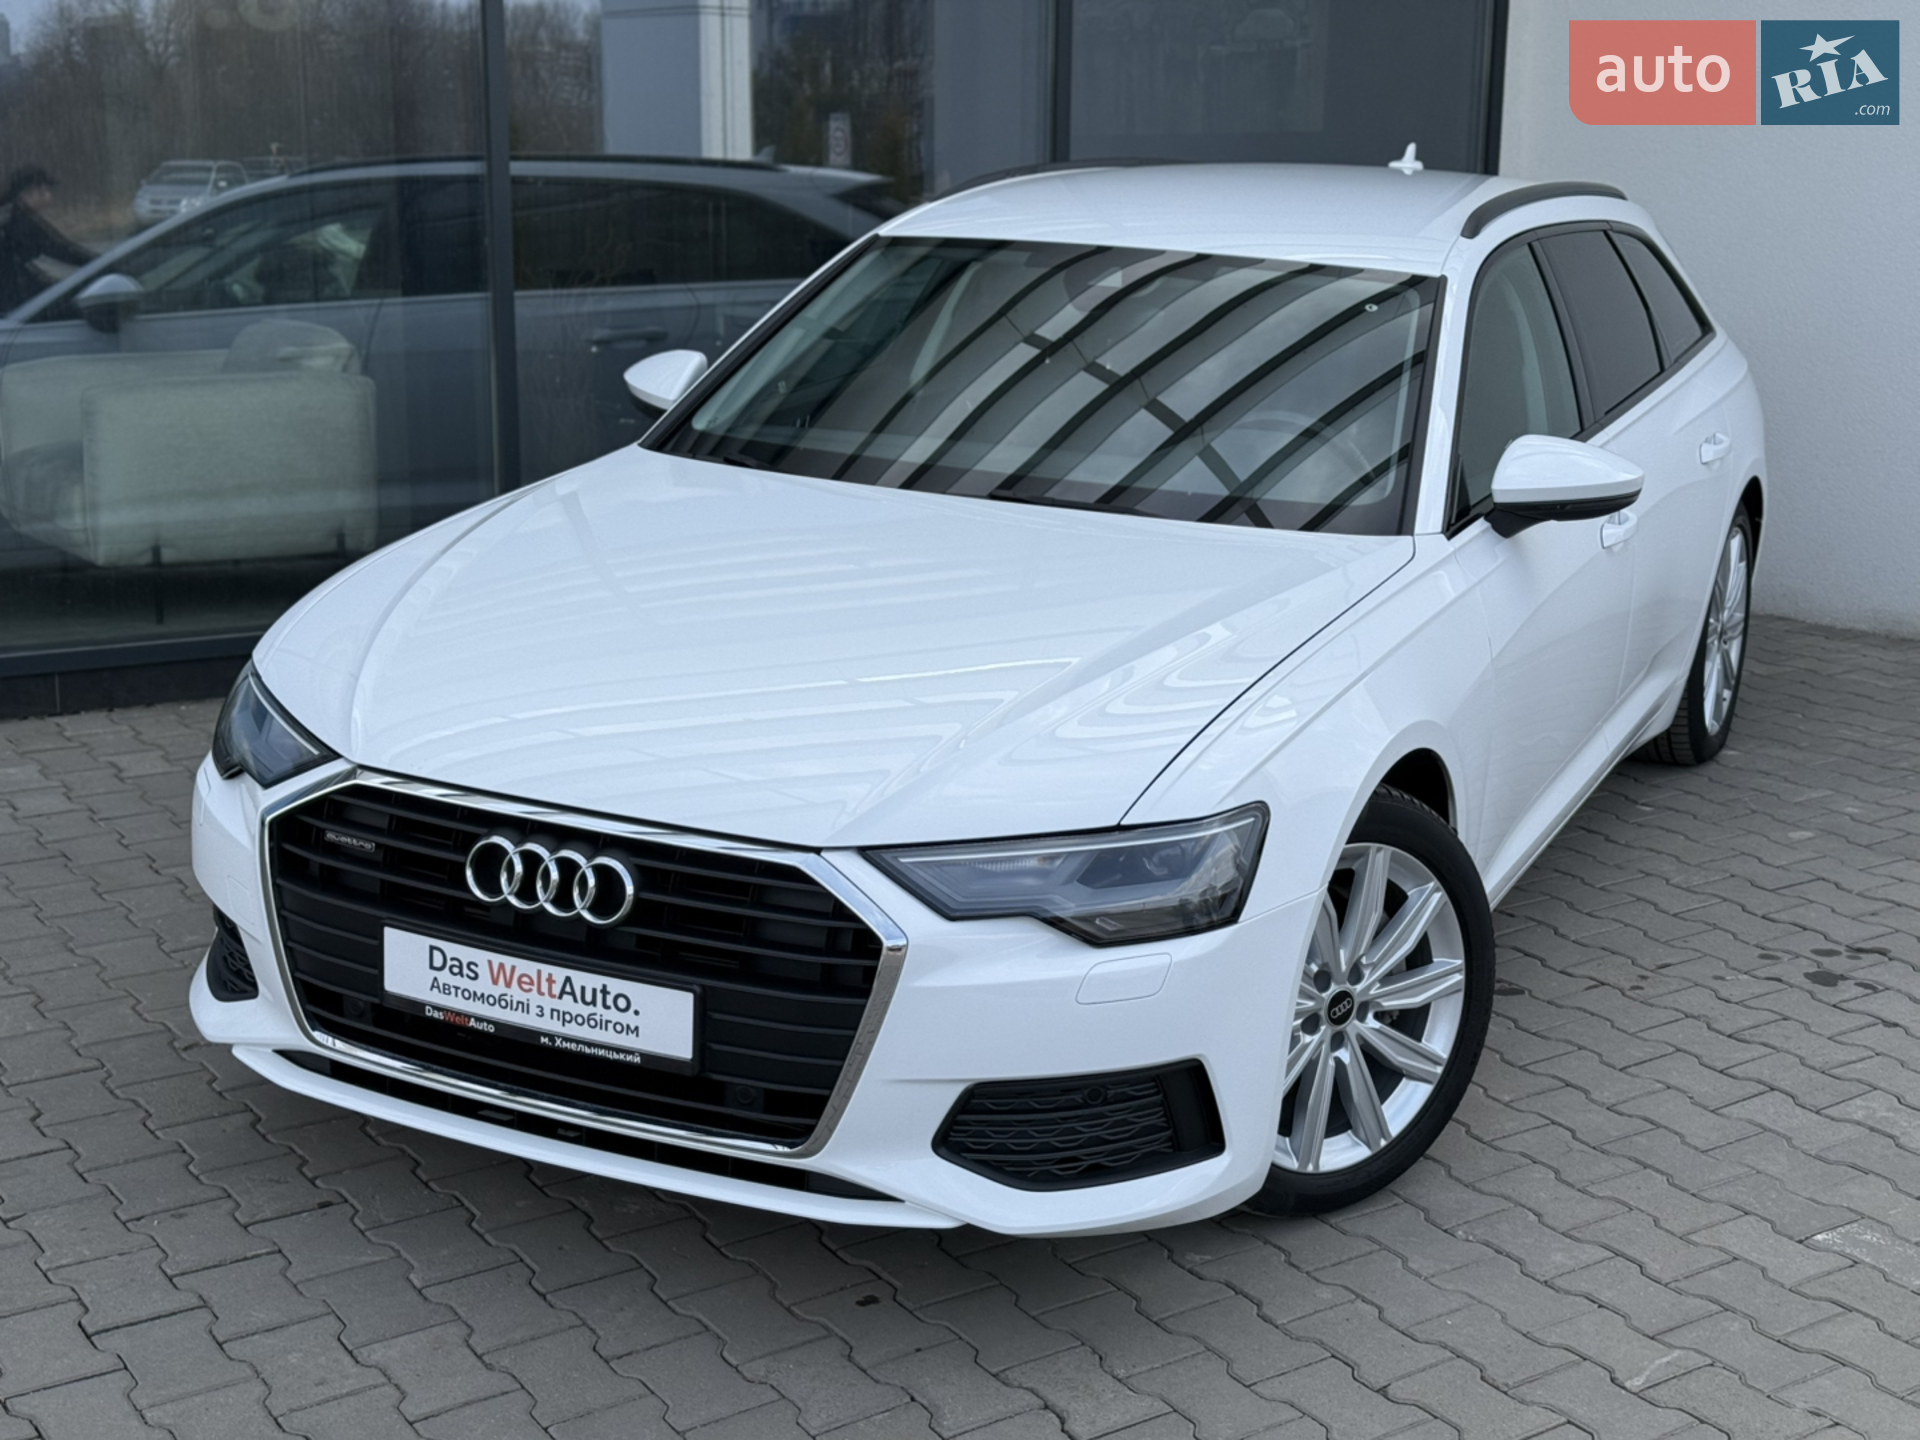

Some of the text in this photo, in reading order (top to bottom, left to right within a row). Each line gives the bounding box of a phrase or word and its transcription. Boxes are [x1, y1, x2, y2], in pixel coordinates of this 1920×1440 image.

[428, 944, 641, 1016] Das WeltAuto.
[425, 1006, 495, 1033] DasWeltAuto
[429, 977, 640, 1038] Автомобілі з пробігом
[540, 1035, 641, 1064] м. Хмельницький
